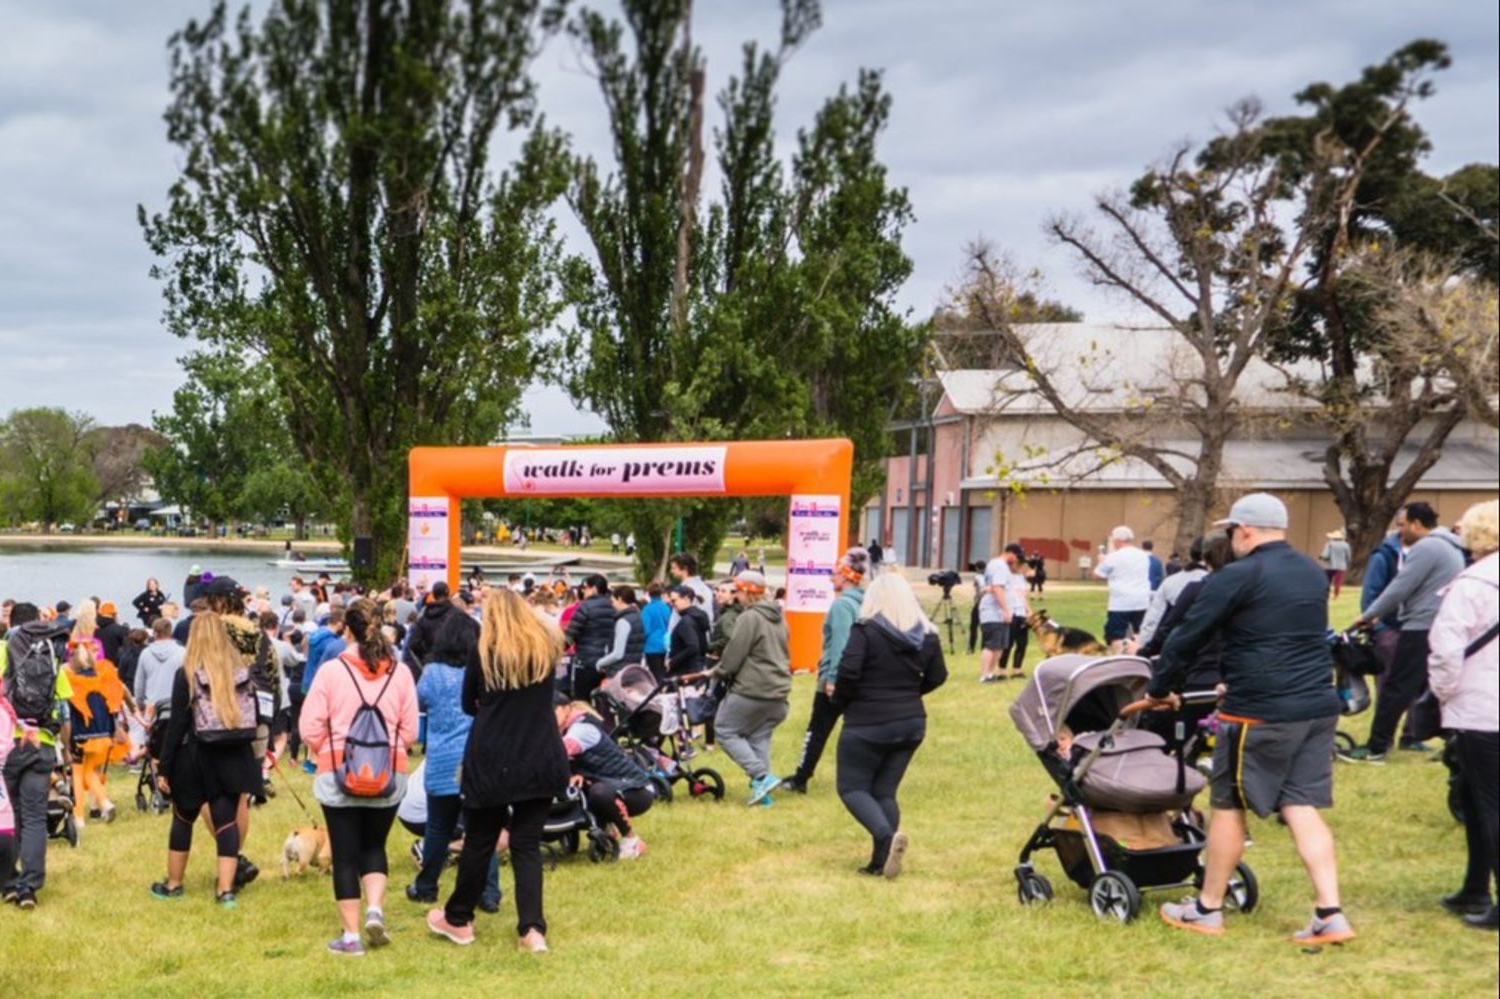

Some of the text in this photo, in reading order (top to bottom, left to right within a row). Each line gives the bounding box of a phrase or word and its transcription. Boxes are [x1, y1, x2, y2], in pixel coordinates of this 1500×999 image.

[524, 460, 716, 483] walk for prems
